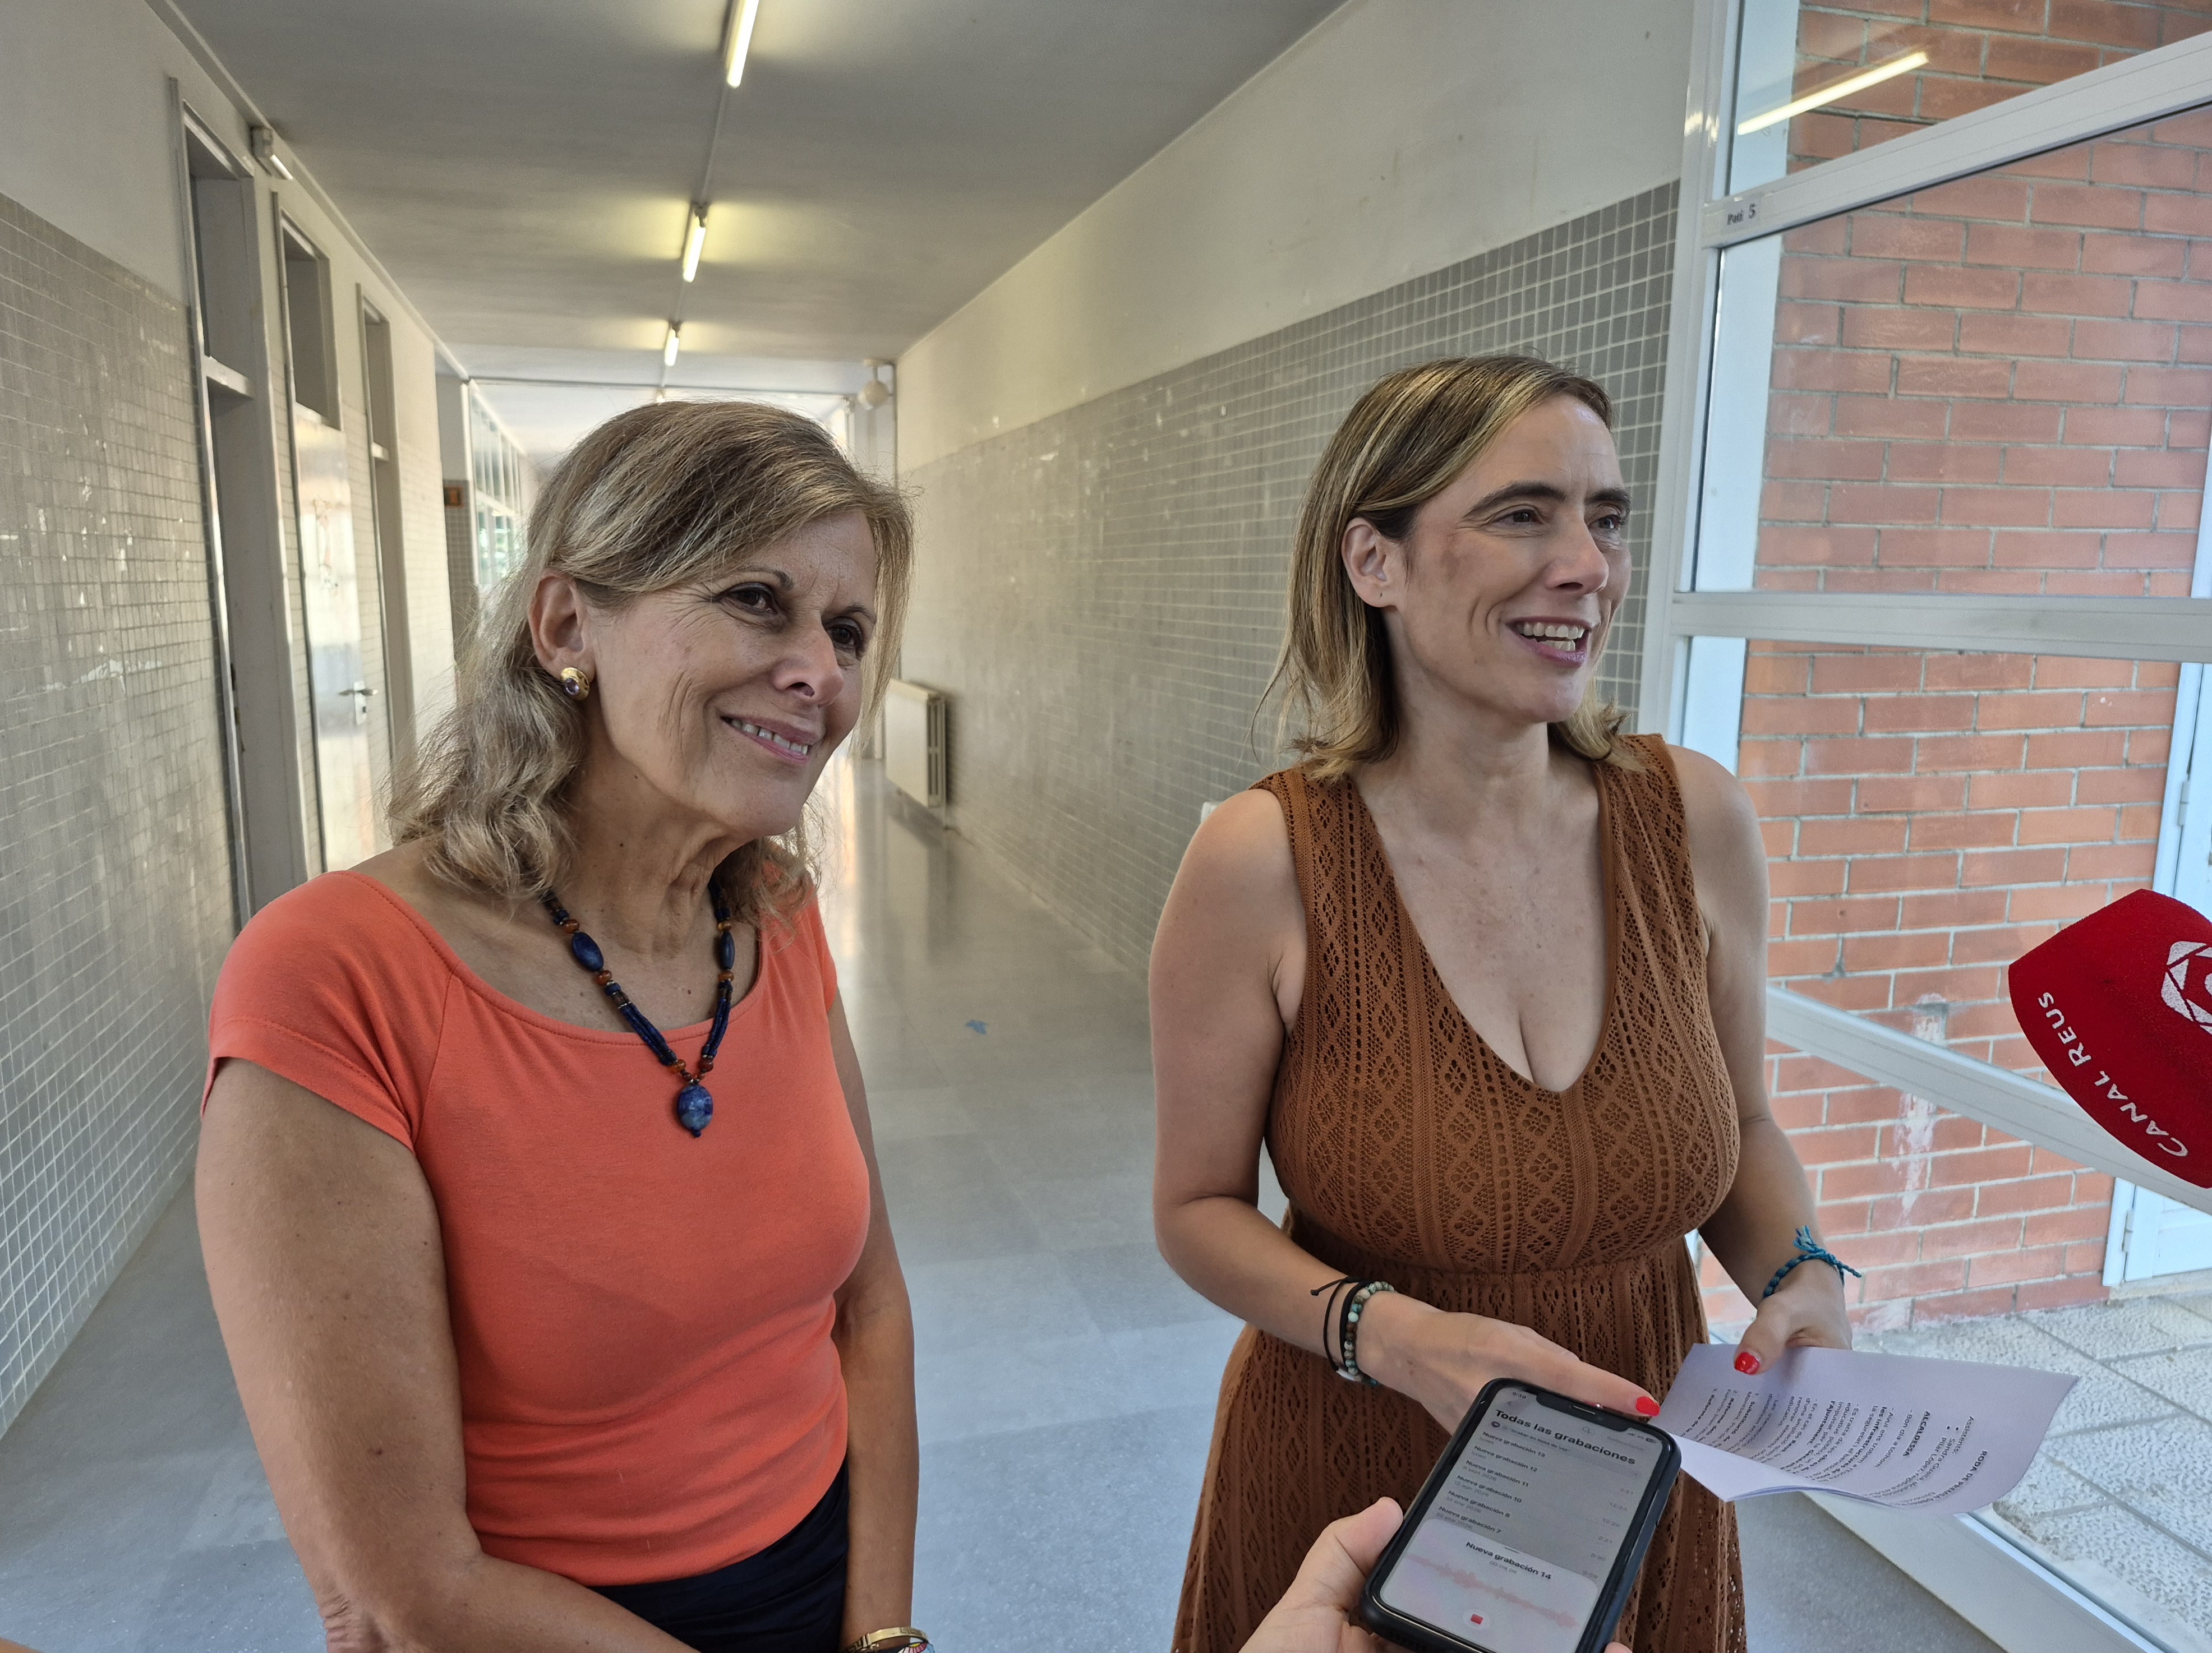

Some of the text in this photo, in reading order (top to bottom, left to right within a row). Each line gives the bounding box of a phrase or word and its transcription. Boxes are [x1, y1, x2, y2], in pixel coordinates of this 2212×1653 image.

[1748, 202, 1756, 219] 5
[2038, 992, 2188, 1156] CANAL REUS
[1698, 1394, 1715, 1419] Reforma
[1717, 1398, 1734, 1423] Reforma
[1731, 1401, 1755, 1434] Substitució
[1789, 1397, 1802, 1422] renovar
[1810, 1403, 1817, 1411] En
[1827, 1402, 1844, 1430] impulsat
[1833, 1402, 1851, 1434] educatius
[1878, 1407, 1887, 1417] les
[1780, 1418, 1801, 1444] ampliació
[1800, 1420, 1809, 1430] cas
[1841, 1417, 1855, 1436] tracta
[1854, 1414, 1874, 1444] seguretat
[1883, 1412, 1893, 1428] Avui
[1902, 1414, 1913, 1428] Bon
[1482, 1432, 1503, 1442] Nueva
[1504, 1439, 1536, 1454] grabación
[1496, 1409, 1531, 1427] Todas
[1533, 1424, 1552, 1435] las
[1554, 1432, 1636, 1465] grabaciones
[1767, 1424, 1789, 1448] elements
[1820, 1432, 1828, 1442] per
[1841, 1419, 1881, 1469] infraestructures
[1877, 1429, 1886, 1441] ens
[1902, 1411, 1930, 1457] ALCALDESSA
[1934, 1437, 1947, 1452] Pilar
[1474, 1446, 1495, 1456] Nueva
[1495, 1454, 1528, 1469] grabación
[1858, 1443, 1877, 1463] trobem
[1938, 1438, 1955, 1462] Sandra
[1970, 1451, 1988, 1471] RODA
[1466, 1460, 1486, 1470] Nueva
[1487, 1469, 1520, 1484] grabación
[1457, 1475, 1478, 1486] Nueva
[1478, 1484, 1512, 1500] grabación
[1448, 1490, 1469, 1502] Nueva
[1470, 1500, 1504, 1515] grabación
[1439, 1506, 1460, 1517] Nueva
[1460, 1516, 1495, 1531] grabación
[1466, 1541, 1493, 1556] Nueva
[1494, 1554, 1538, 1574] grabación
